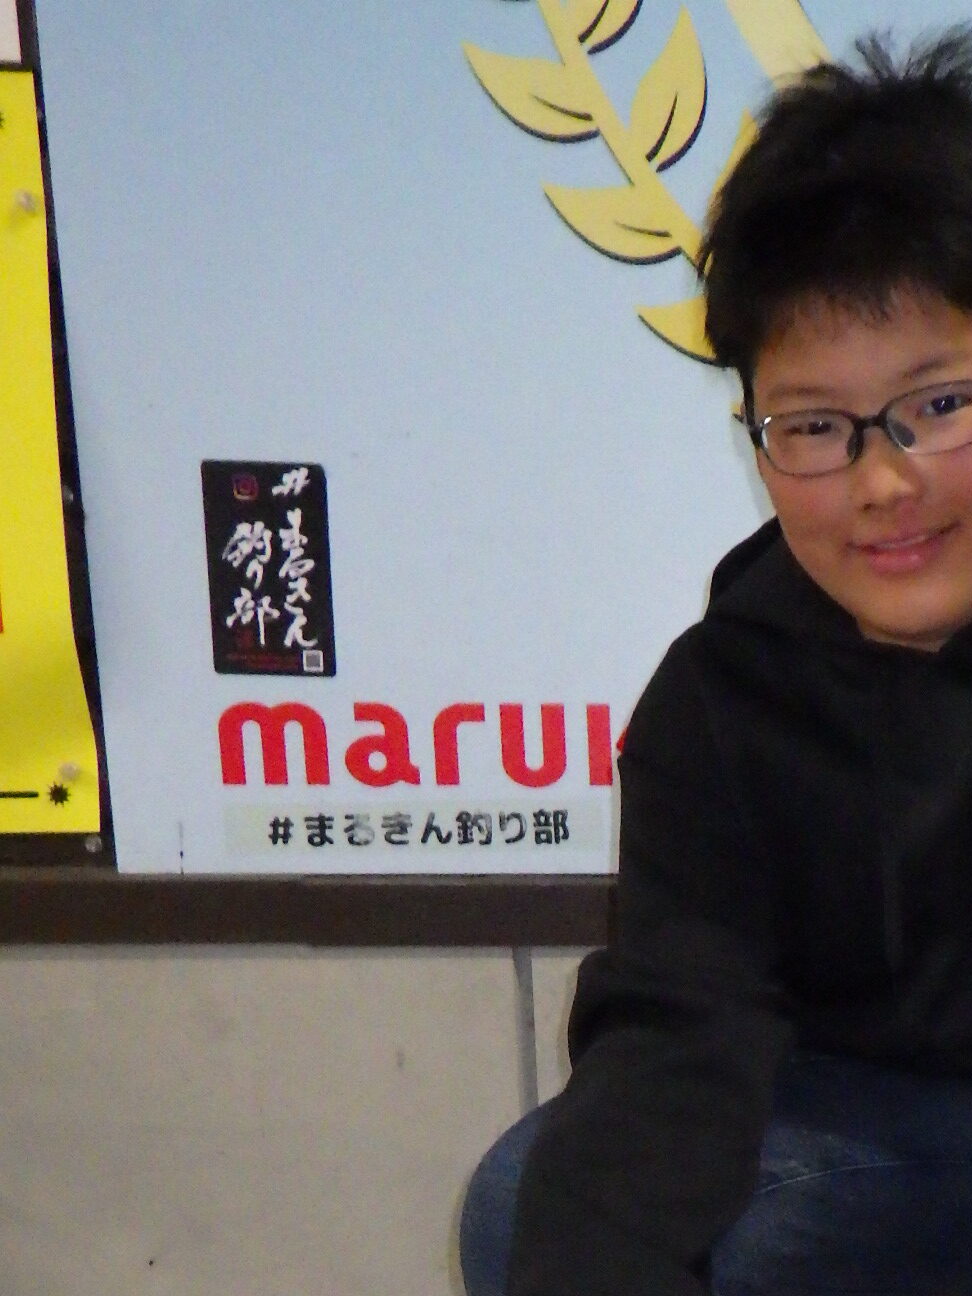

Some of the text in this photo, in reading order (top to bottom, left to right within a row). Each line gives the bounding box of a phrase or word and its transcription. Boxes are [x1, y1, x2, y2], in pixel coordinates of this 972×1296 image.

[267, 809, 570, 846] #まるきん釣り部
